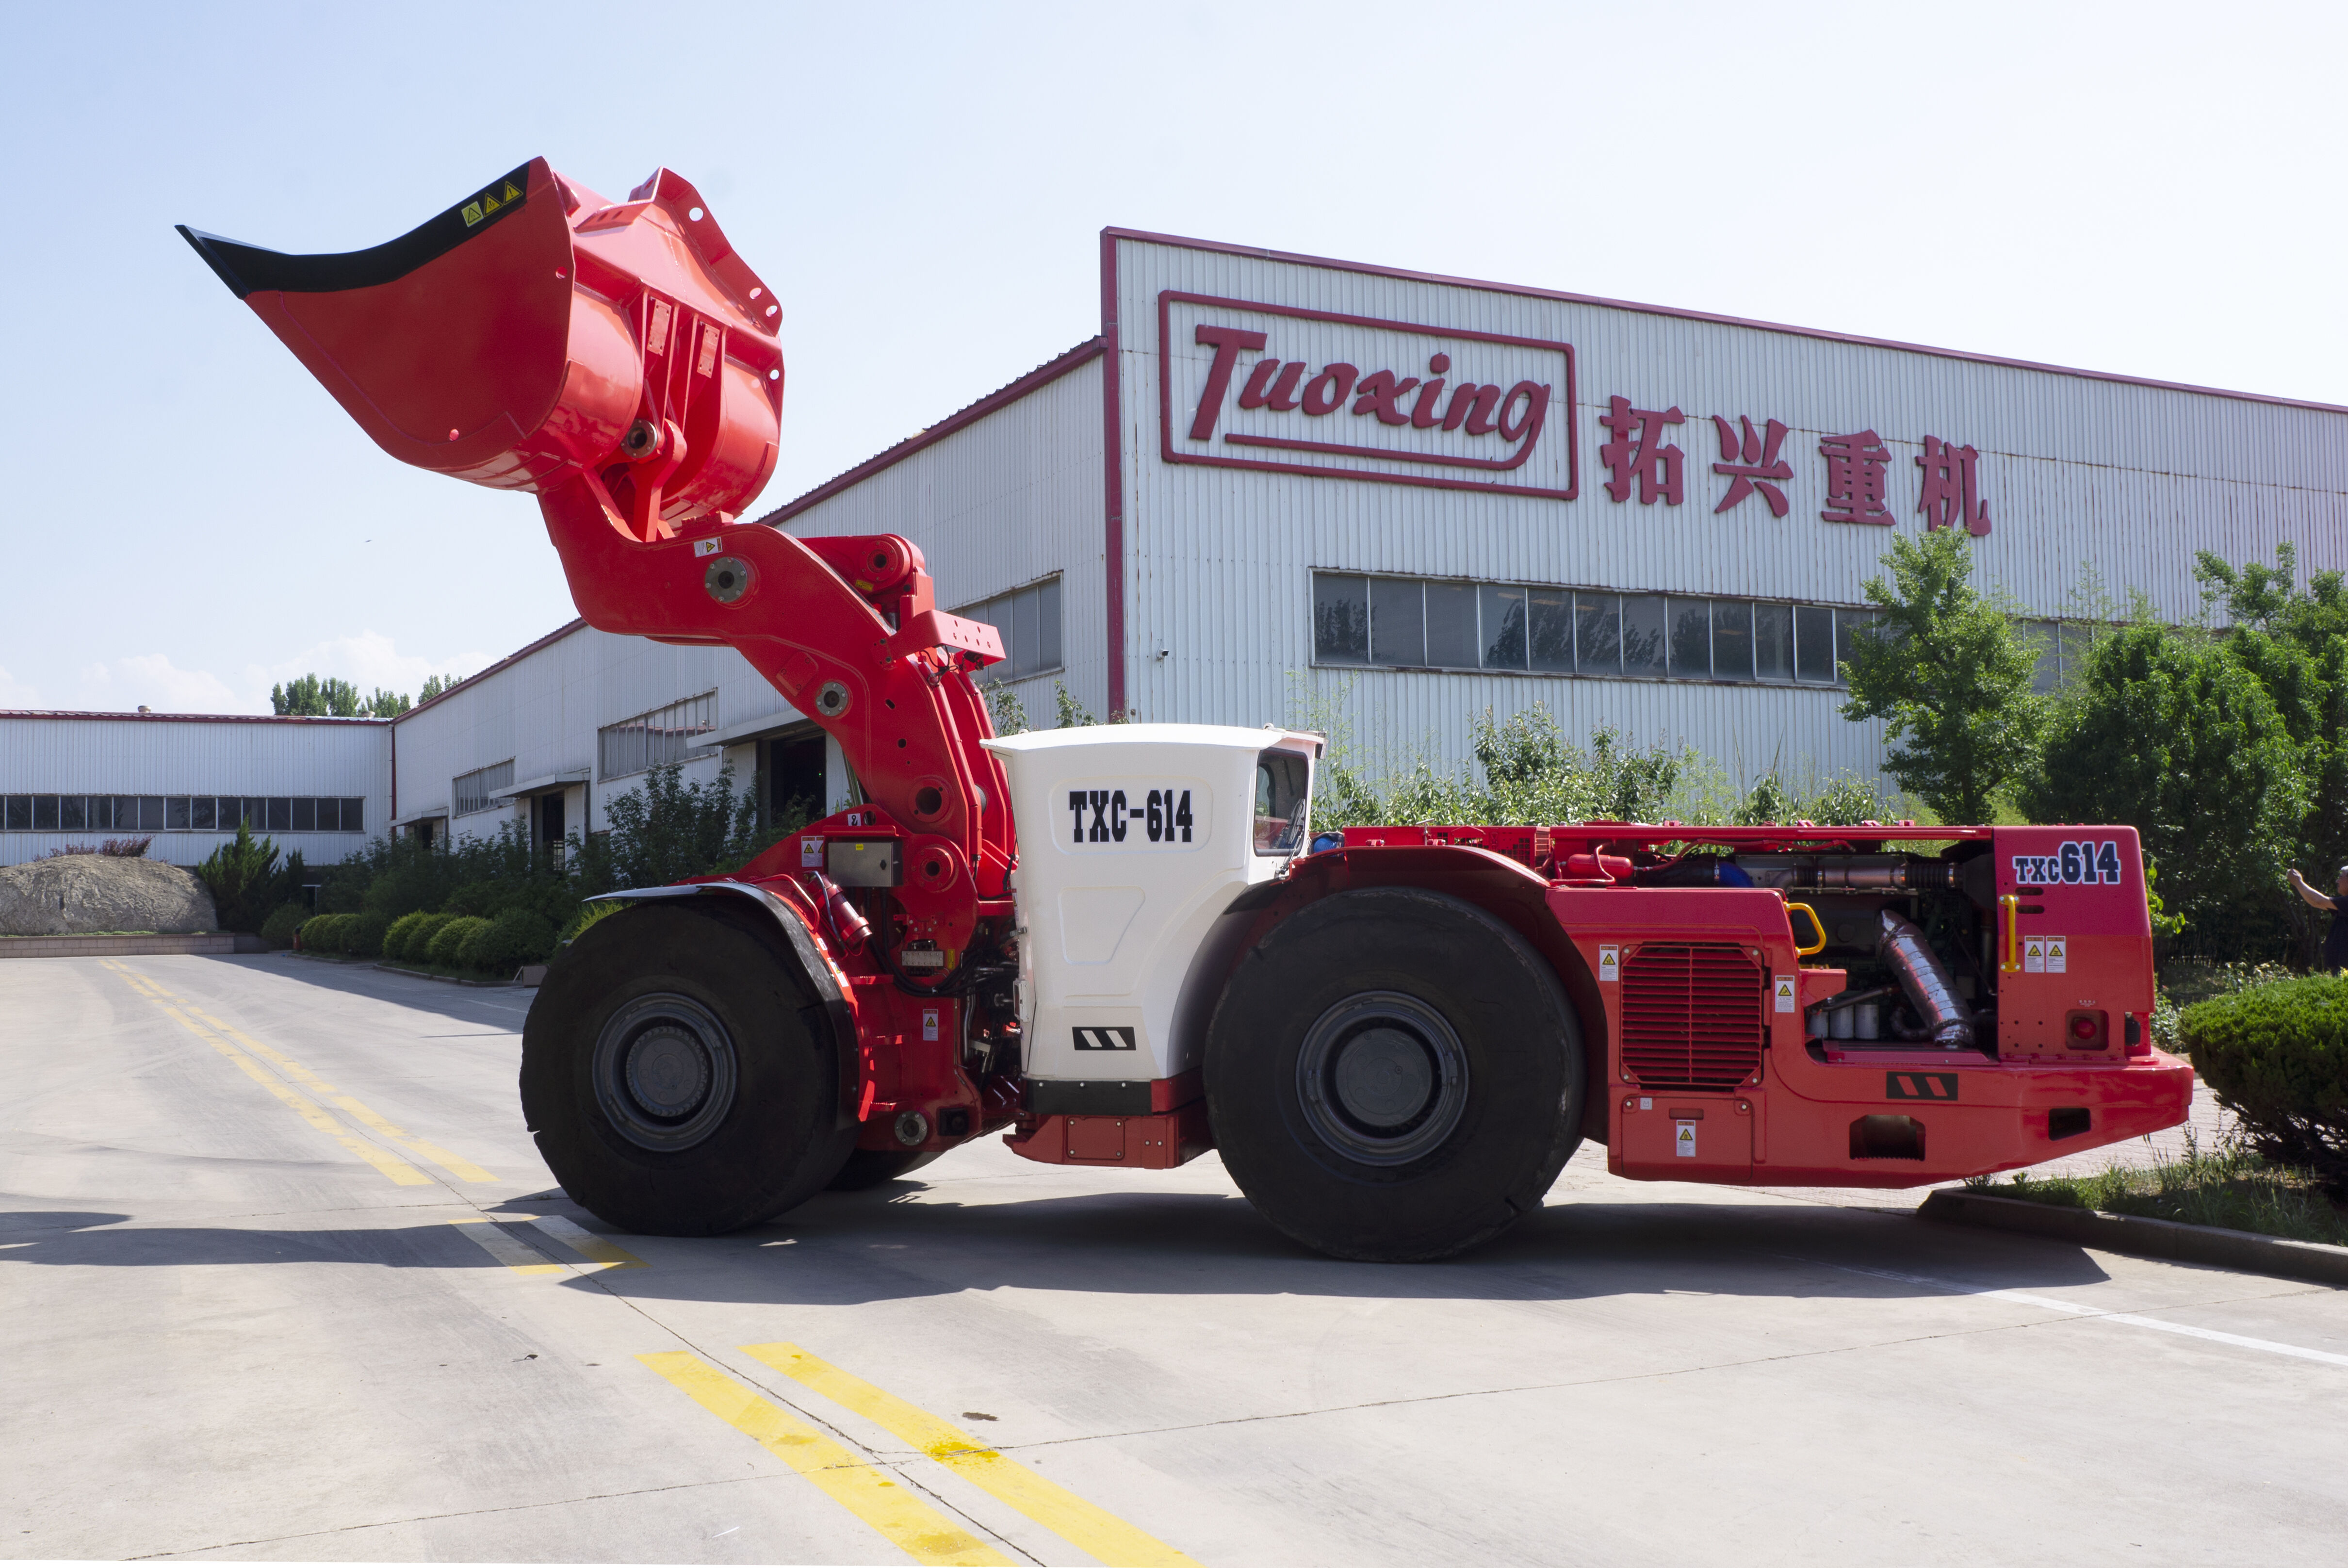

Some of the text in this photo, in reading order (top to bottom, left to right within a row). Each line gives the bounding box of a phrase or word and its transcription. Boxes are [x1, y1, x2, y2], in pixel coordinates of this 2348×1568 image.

[1190, 324, 1551, 470] Tuoxing
[1599, 395, 1991, 536] 拓兴重机
[1069, 789, 1193, 843] TXC-614
[2013, 842, 2120, 883] TXC614
